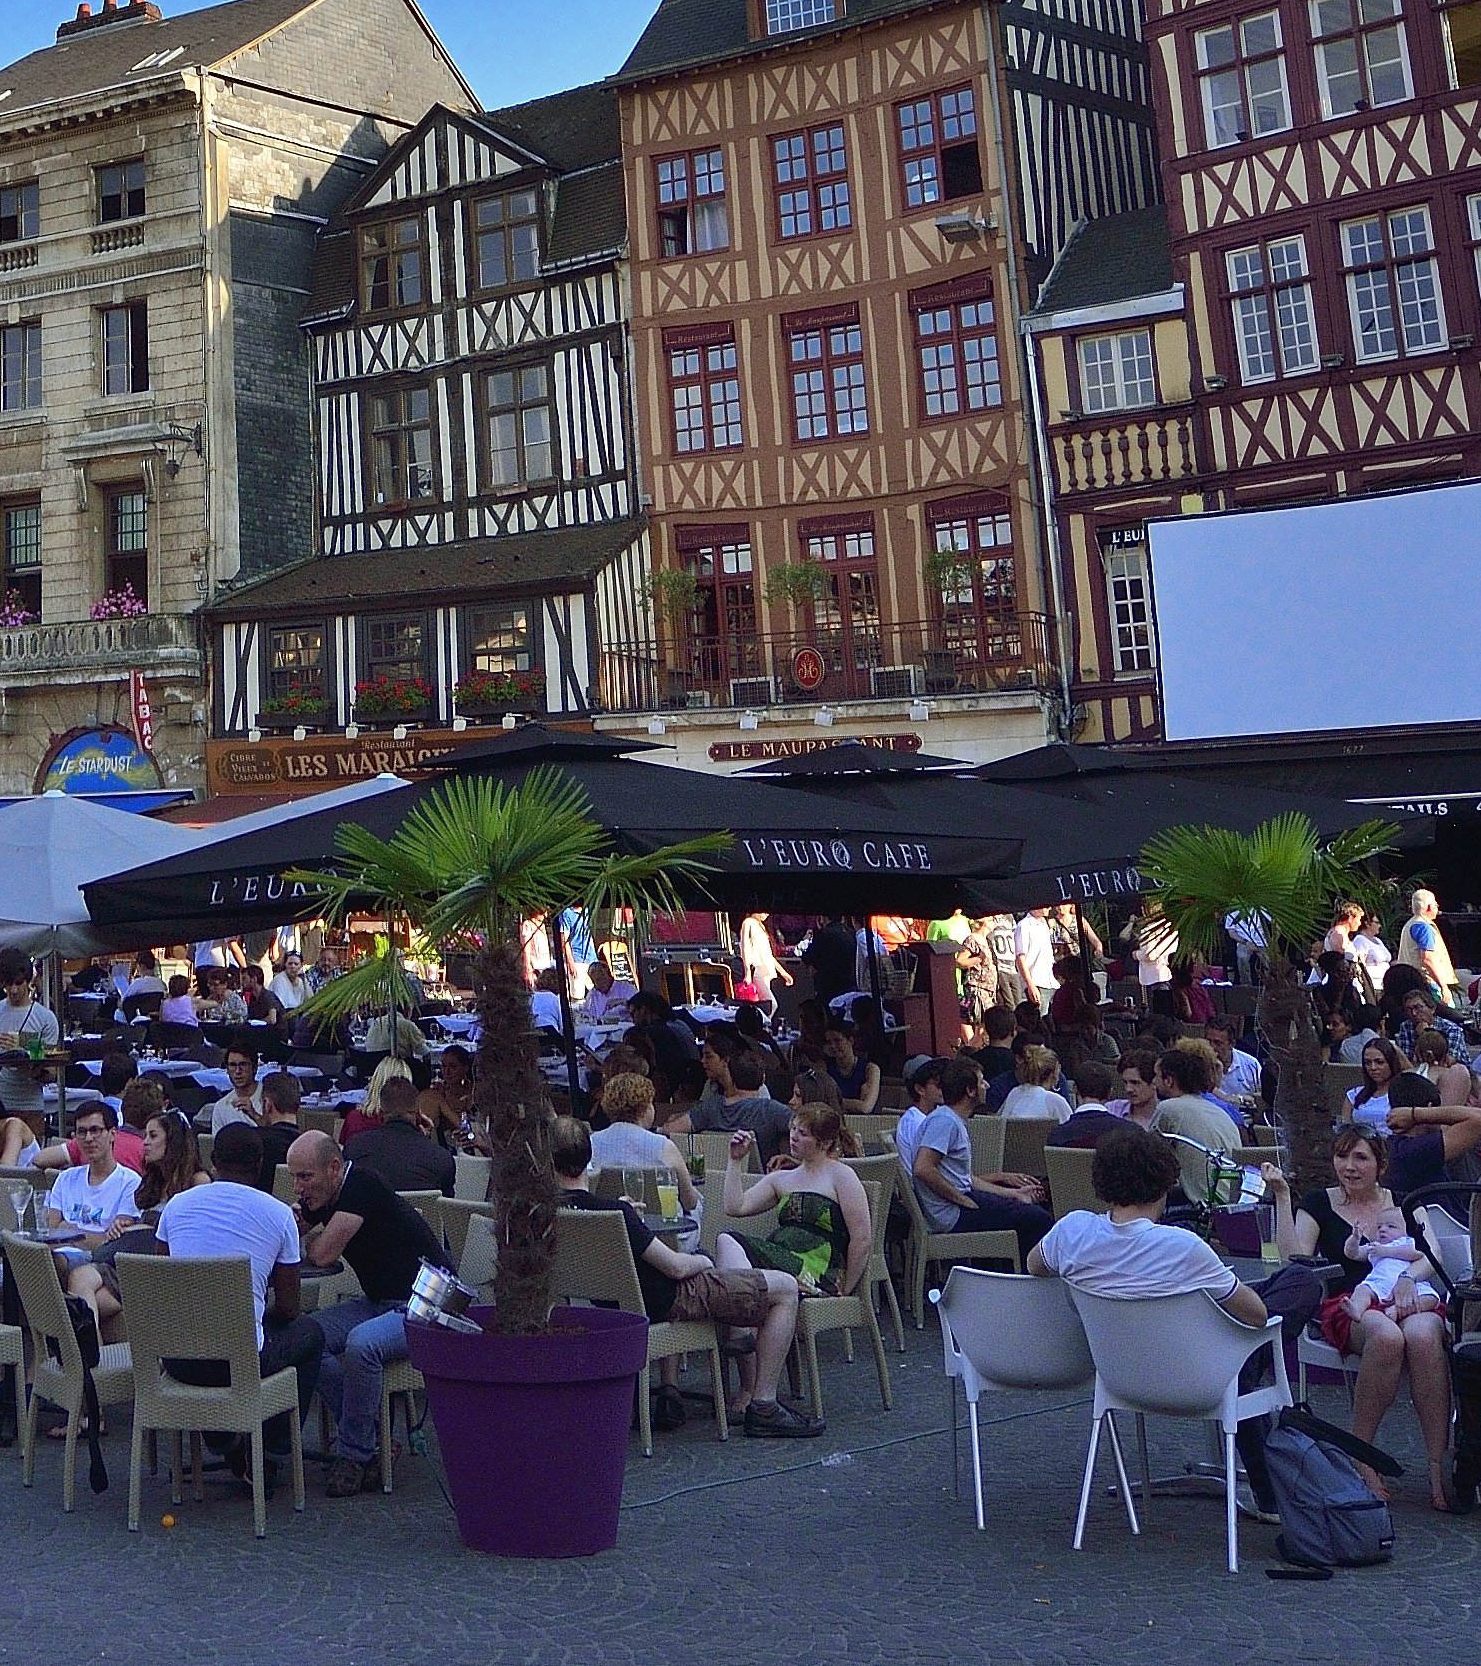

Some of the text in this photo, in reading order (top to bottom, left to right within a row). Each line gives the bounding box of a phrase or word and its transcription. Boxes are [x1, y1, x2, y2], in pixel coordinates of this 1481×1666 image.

[677, 331, 718, 344] Restaurant
[137, 673, 153, 750] TABAC
[361, 738, 417, 751] Restaurant
[730, 745, 751, 758] LE
[78, 754, 132, 774] STARDUST
[285, 754, 329, 778] LES
[863, 841, 931, 870] CAFE
